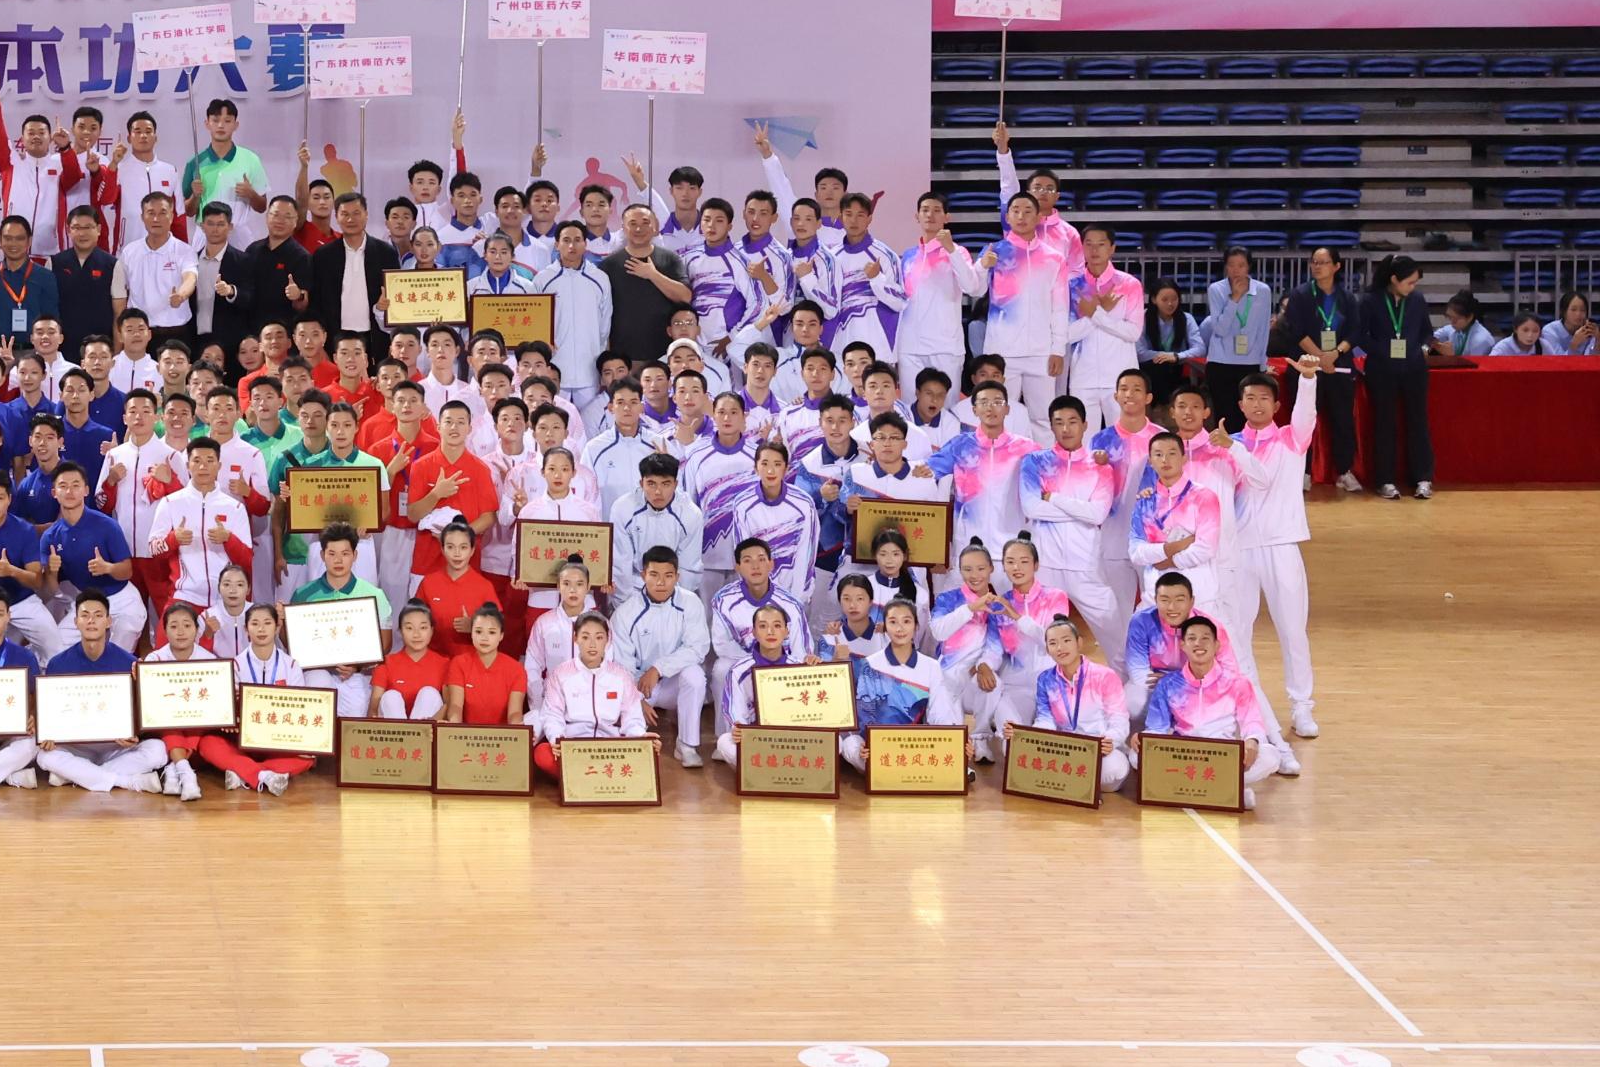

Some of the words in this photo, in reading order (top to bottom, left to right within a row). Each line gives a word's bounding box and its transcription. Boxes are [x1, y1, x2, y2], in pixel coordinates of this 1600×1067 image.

[496, 0, 583, 12] 广州中医药大学
[140, 24, 227, 40] 广东石油化工学院
[315, 56, 408, 69] 广东技术师范大学
[613, 51, 696, 64] 华南师范大学
[394, 291, 457, 304] 道德风尚奖
[492, 315, 532, 327] 三等奖
[298, 493, 368, 507] 道德风尚奖
[162, 686, 210, 702] 一等奖
[780, 690, 829, 706] 一等奖
[251, 710, 324, 728] 道德风尚奖
[350, 745, 423, 762] 道德风尚奖
[459, 751, 508, 767] 二等奖
[750, 753, 825, 769] 道德风尚奖
[879, 753, 955, 767] 道德风尚奖
[585, 762, 633, 779] 二等奖
[1017, 754, 1088, 778] 道德风尚奖
[1165, 764, 1215, 782] 一等奖
